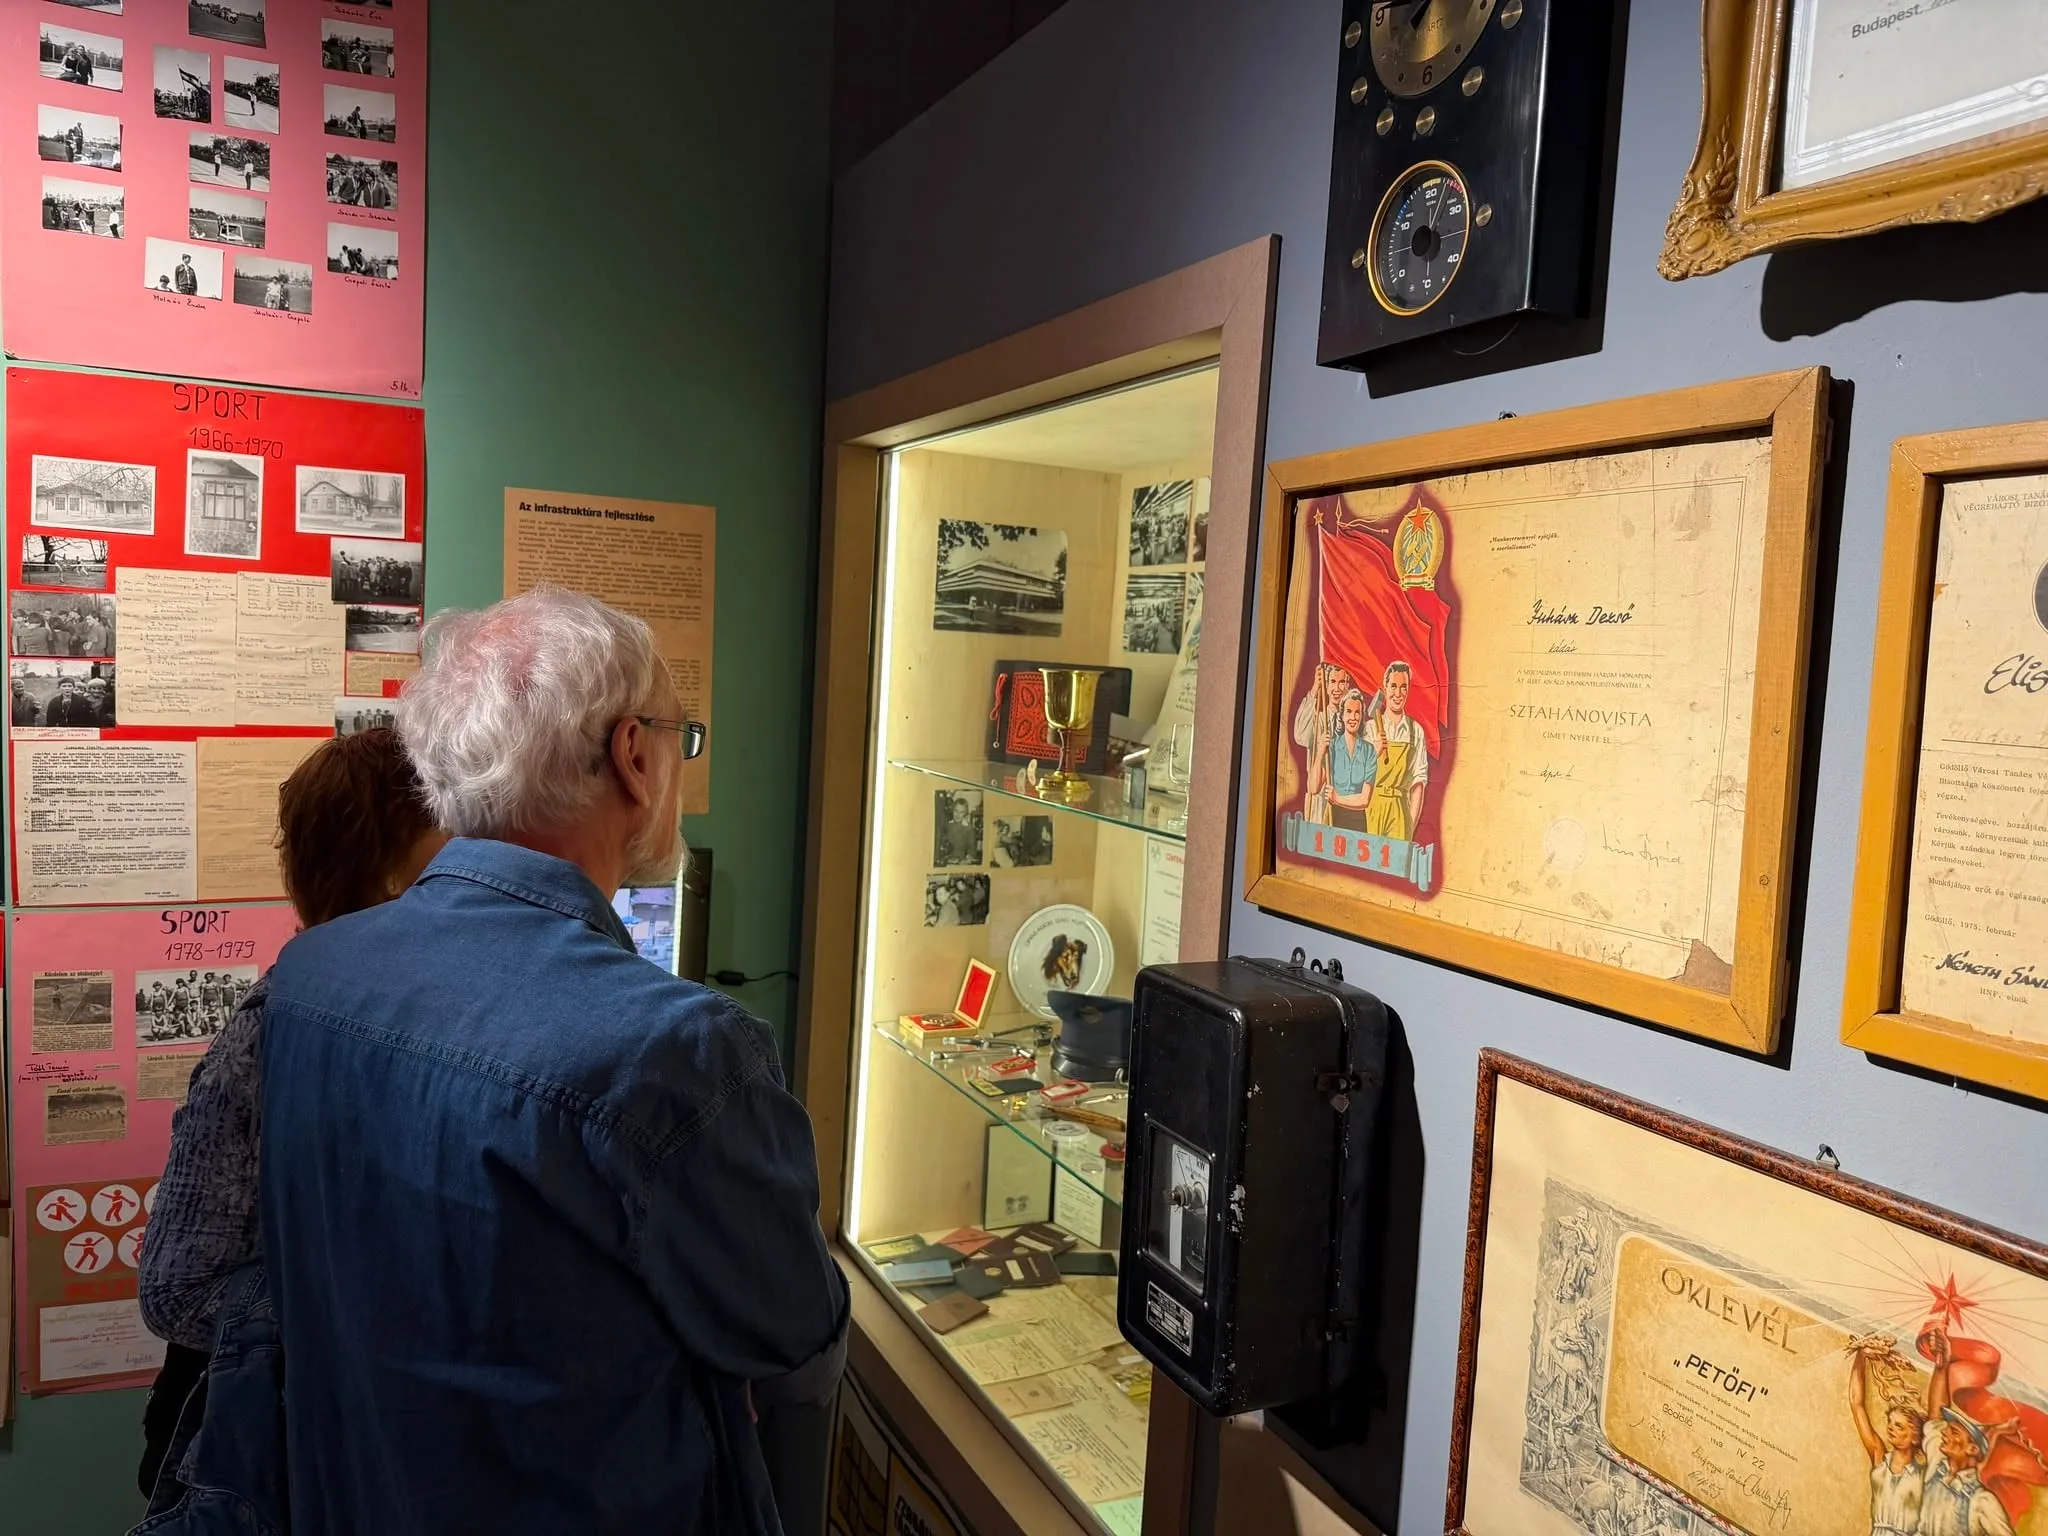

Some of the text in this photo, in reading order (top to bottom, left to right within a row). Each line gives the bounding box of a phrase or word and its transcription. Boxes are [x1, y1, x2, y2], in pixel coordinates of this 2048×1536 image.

[1375, 7, 1385, 27] 9
[1422, 65, 1433, 85] 6
[1425, 188, 1438, 199] 20
[1449, 204, 1462, 215] 30
[1401, 221, 1411, 231] 10
[1447, 253, 1460, 263] 40
[1398, 269, 1406, 278] 0
[1422, 278, 1432, 289] °C
[173, 383, 266, 421] SPORT
[189, 427, 284, 460] 1966-1970
[519, 501, 655, 522] Az infrastruktúra fejlesztése
[1509, 703, 1652, 727] SZTAHÁNOVISTA
[1542, 731, 1567, 741] CÍMET
[1569, 733, 1599, 744] NYERTE
[1939, 763, 1969, 772] Gödöllő
[1972, 766, 1999, 776] Városi
[2003, 769, 2033, 779] Tanács
[1314, 831, 1391, 868] 1951
[160, 909, 232, 935] SPORT
[1986, 925, 2017, 938] február
[164, 940, 256, 961] 1978-1979
[1661, 1266, 1798, 1355] OKLEVÉL
[1751, 1456, 1766, 1471] 22
